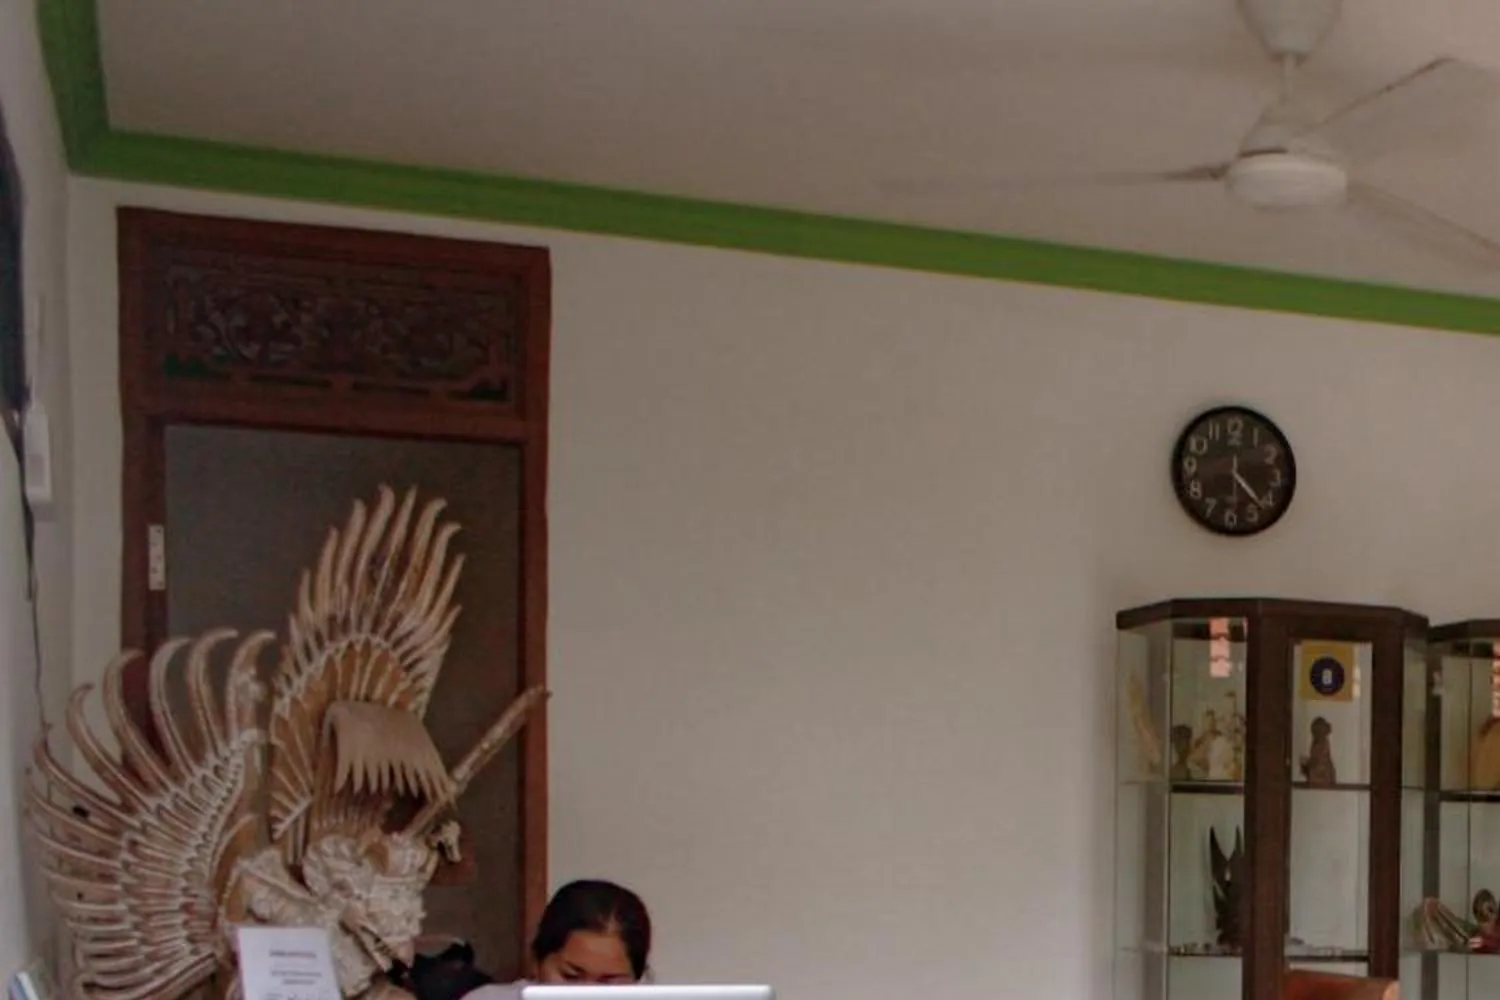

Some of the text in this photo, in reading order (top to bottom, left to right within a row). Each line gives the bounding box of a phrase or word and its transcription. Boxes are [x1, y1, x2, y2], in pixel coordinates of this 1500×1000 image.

[1209, 421, 1221, 441] 11
[1190, 435, 1208, 454] 10
[1190, 480, 1201, 500] 8
[1205, 498, 1217, 518] 7
